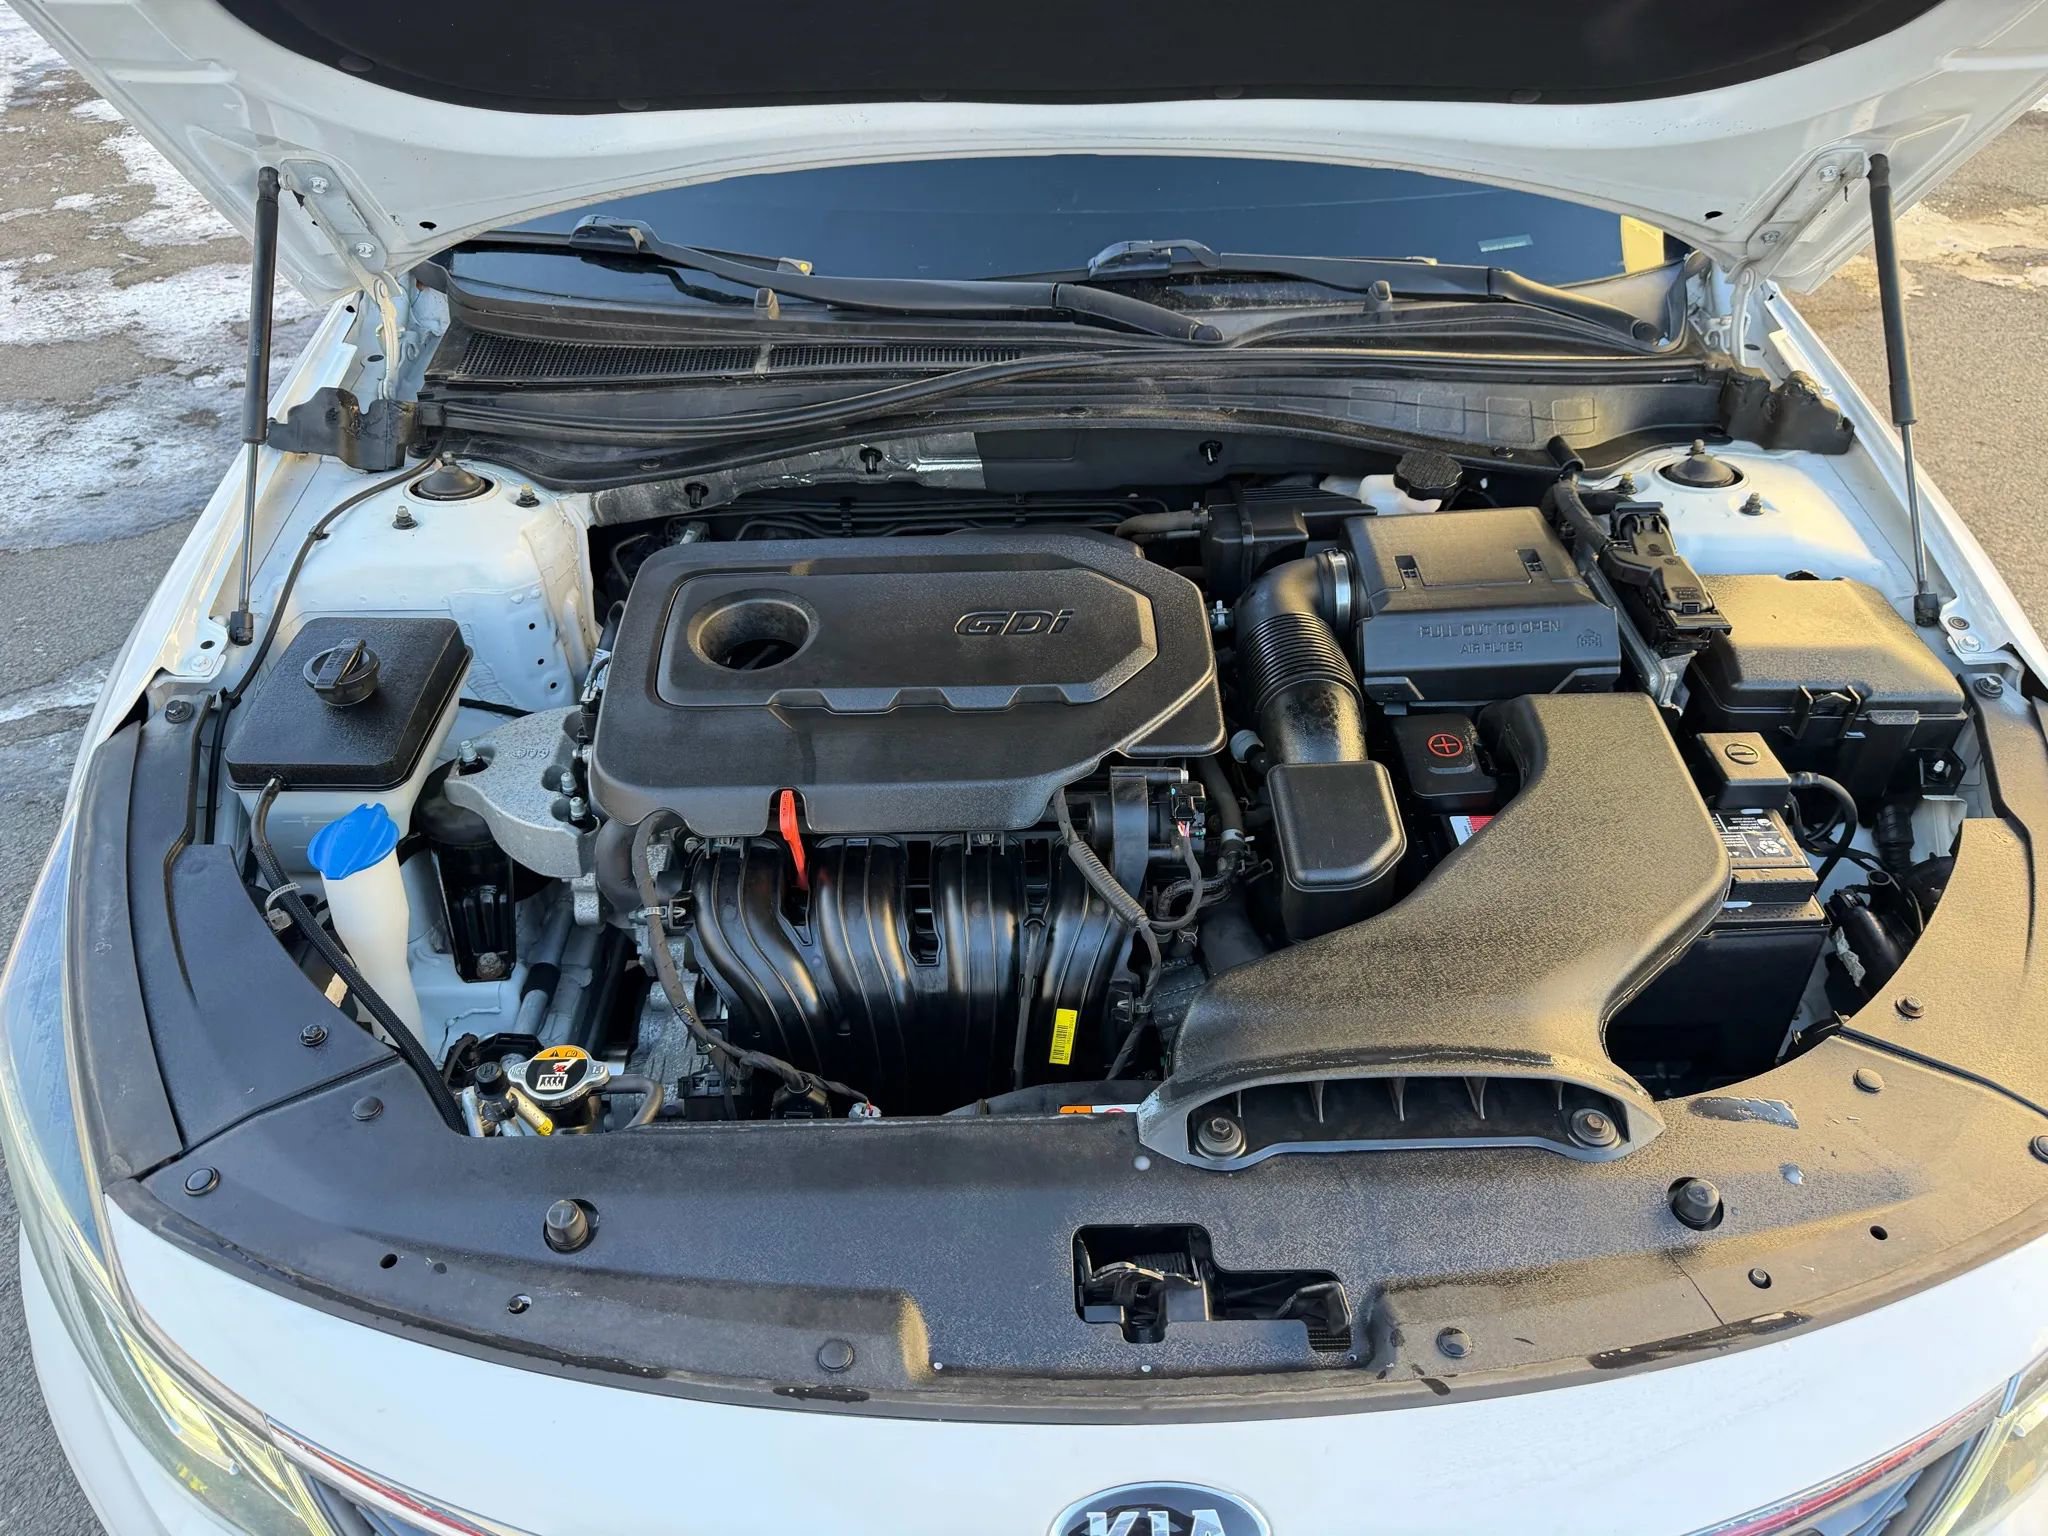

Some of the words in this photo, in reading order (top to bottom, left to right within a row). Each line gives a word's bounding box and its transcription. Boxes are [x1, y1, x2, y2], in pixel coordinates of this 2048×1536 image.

[953, 608, 1075, 636] GDi
[1419, 624, 1457, 639] PULL
[1461, 622, 1493, 637] OUT
[1496, 621, 1516, 636] TO
[1519, 619, 1561, 634] OPEN
[1460, 642, 1480, 655] AIR
[1483, 640, 1524, 653] FILTER
[1086, 1508, 1226, 1536] KIA
